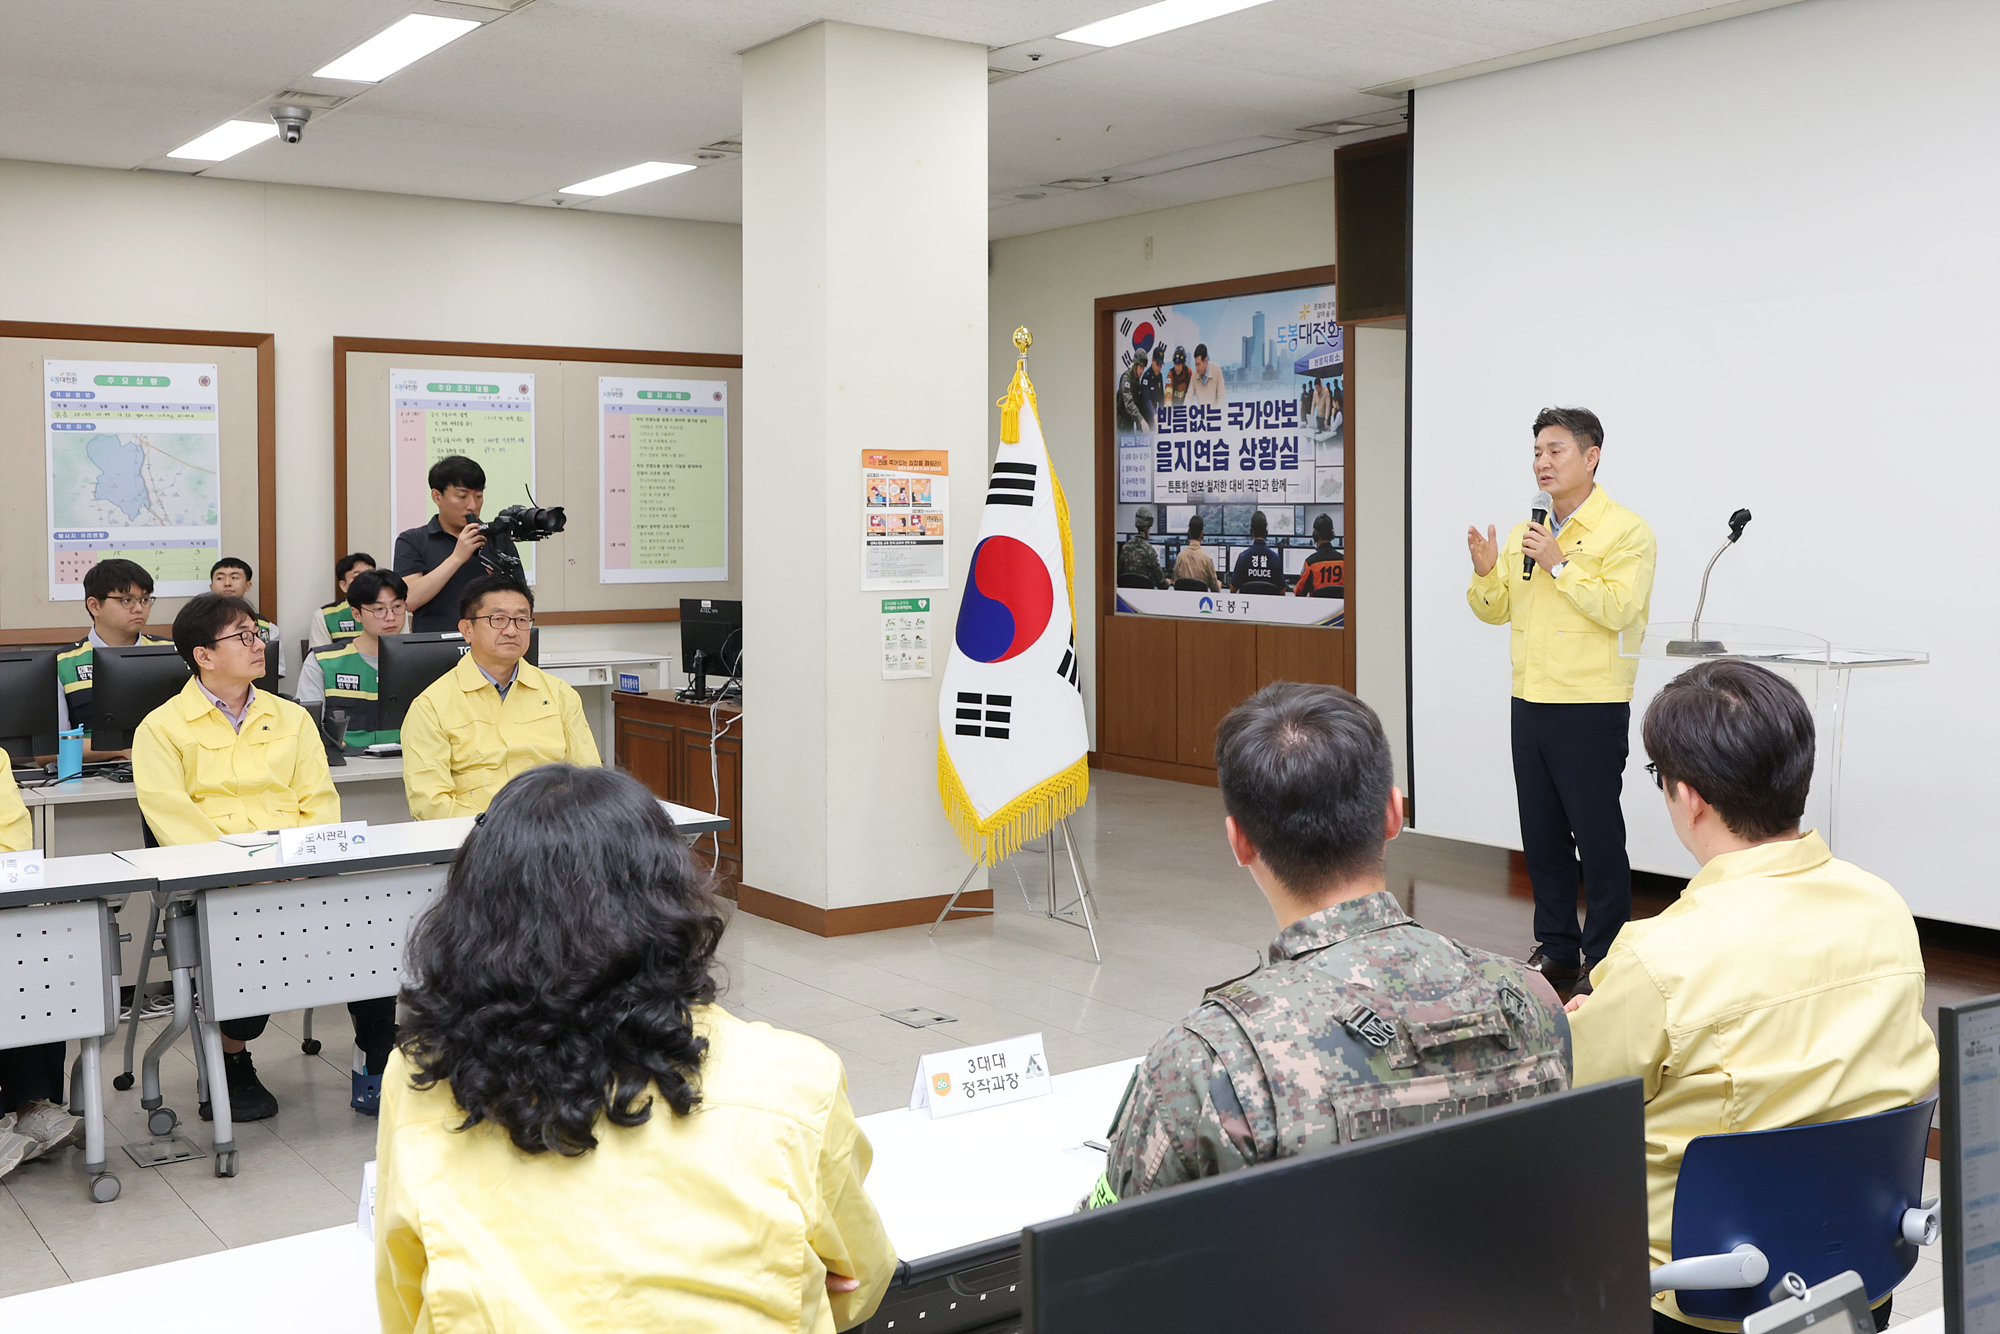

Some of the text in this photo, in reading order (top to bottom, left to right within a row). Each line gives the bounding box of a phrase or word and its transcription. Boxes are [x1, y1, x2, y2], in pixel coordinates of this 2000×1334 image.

[1277, 319, 1342, 352] 도봉대전환
[1314, 352, 1341, 367] 현장지휘소
[438, 384, 453, 392] 주요
[457, 384, 471, 392] 조치
[1157, 399, 1298, 434] 빈틈없는 국가안보
[1156, 435, 1299, 473] 을지연습 상황실
[1167, 480, 1188, 494] 튼튼한
[1271, 478, 1287, 493] 함께
[1251, 555, 1268, 568] 경찰
[1248, 568, 1272, 579] POLICE
[1320, 566, 1342, 584] 119
[305, 830, 347, 843] 도시관리
[967, 1052, 1007, 1075] 3대대
[961, 1072, 1020, 1099] 정작과장
